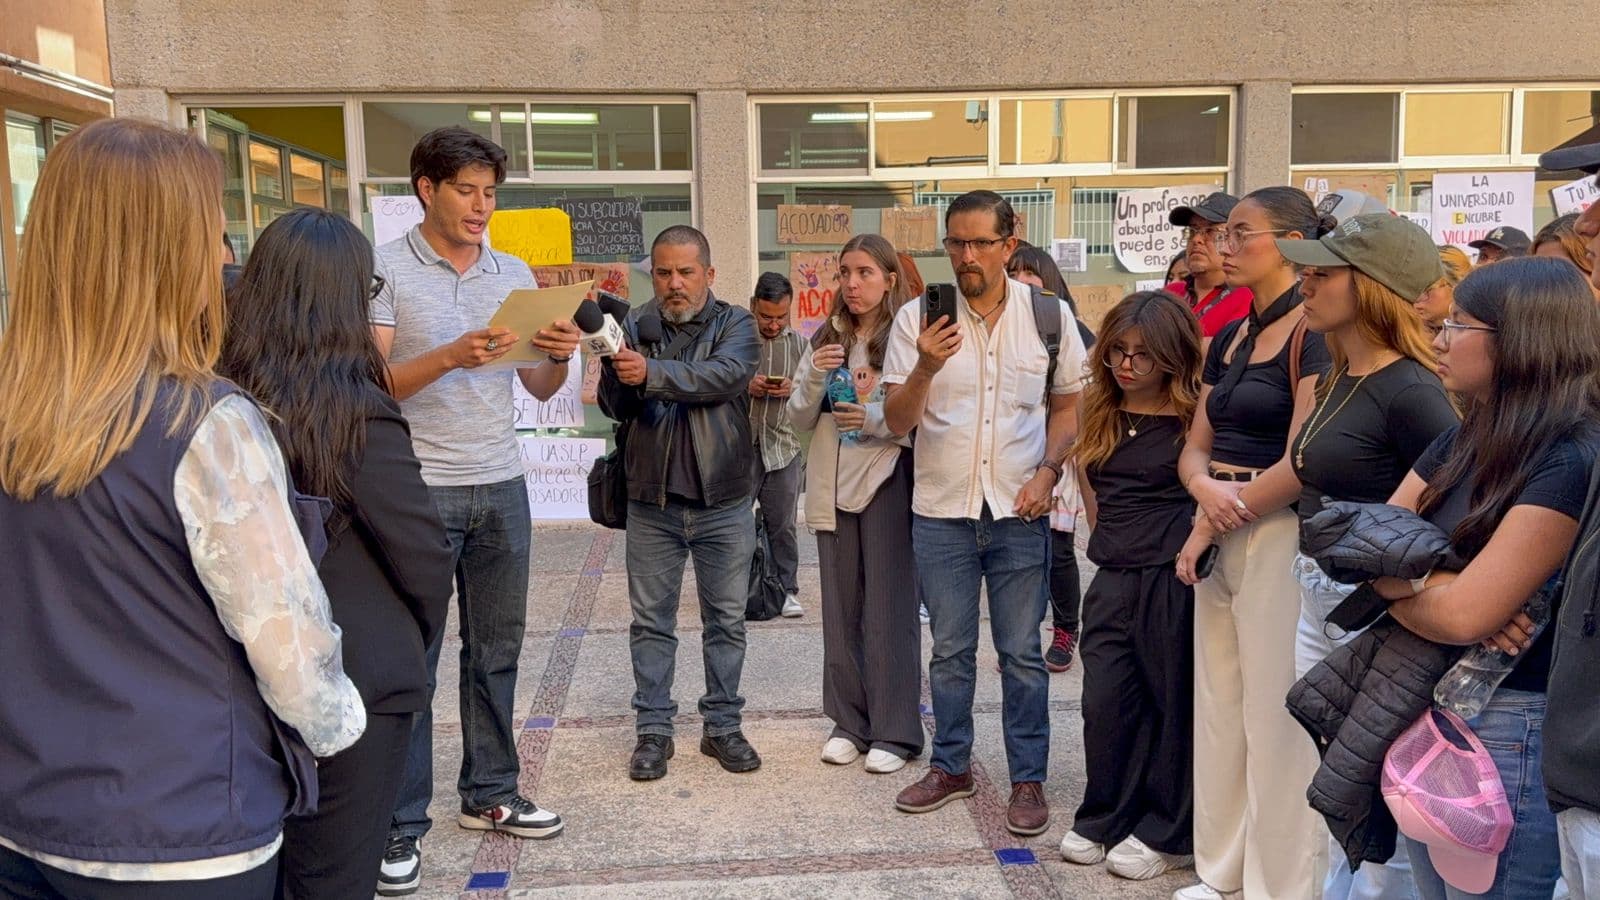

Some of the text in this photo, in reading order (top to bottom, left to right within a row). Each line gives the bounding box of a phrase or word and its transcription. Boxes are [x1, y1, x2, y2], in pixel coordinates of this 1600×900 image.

[1472, 175, 1489, 187] LA
[1117, 196, 1138, 220] Un
[1440, 191, 1515, 208] UNIVERSIDAD
[779, 212, 850, 236] ACOSADOR
[1455, 211, 1502, 224] ENCUBRE
[597, 220, 638, 234] SOCIAL
[1119, 235, 1165, 258] puede
[541, 443, 588, 462] UASLP
